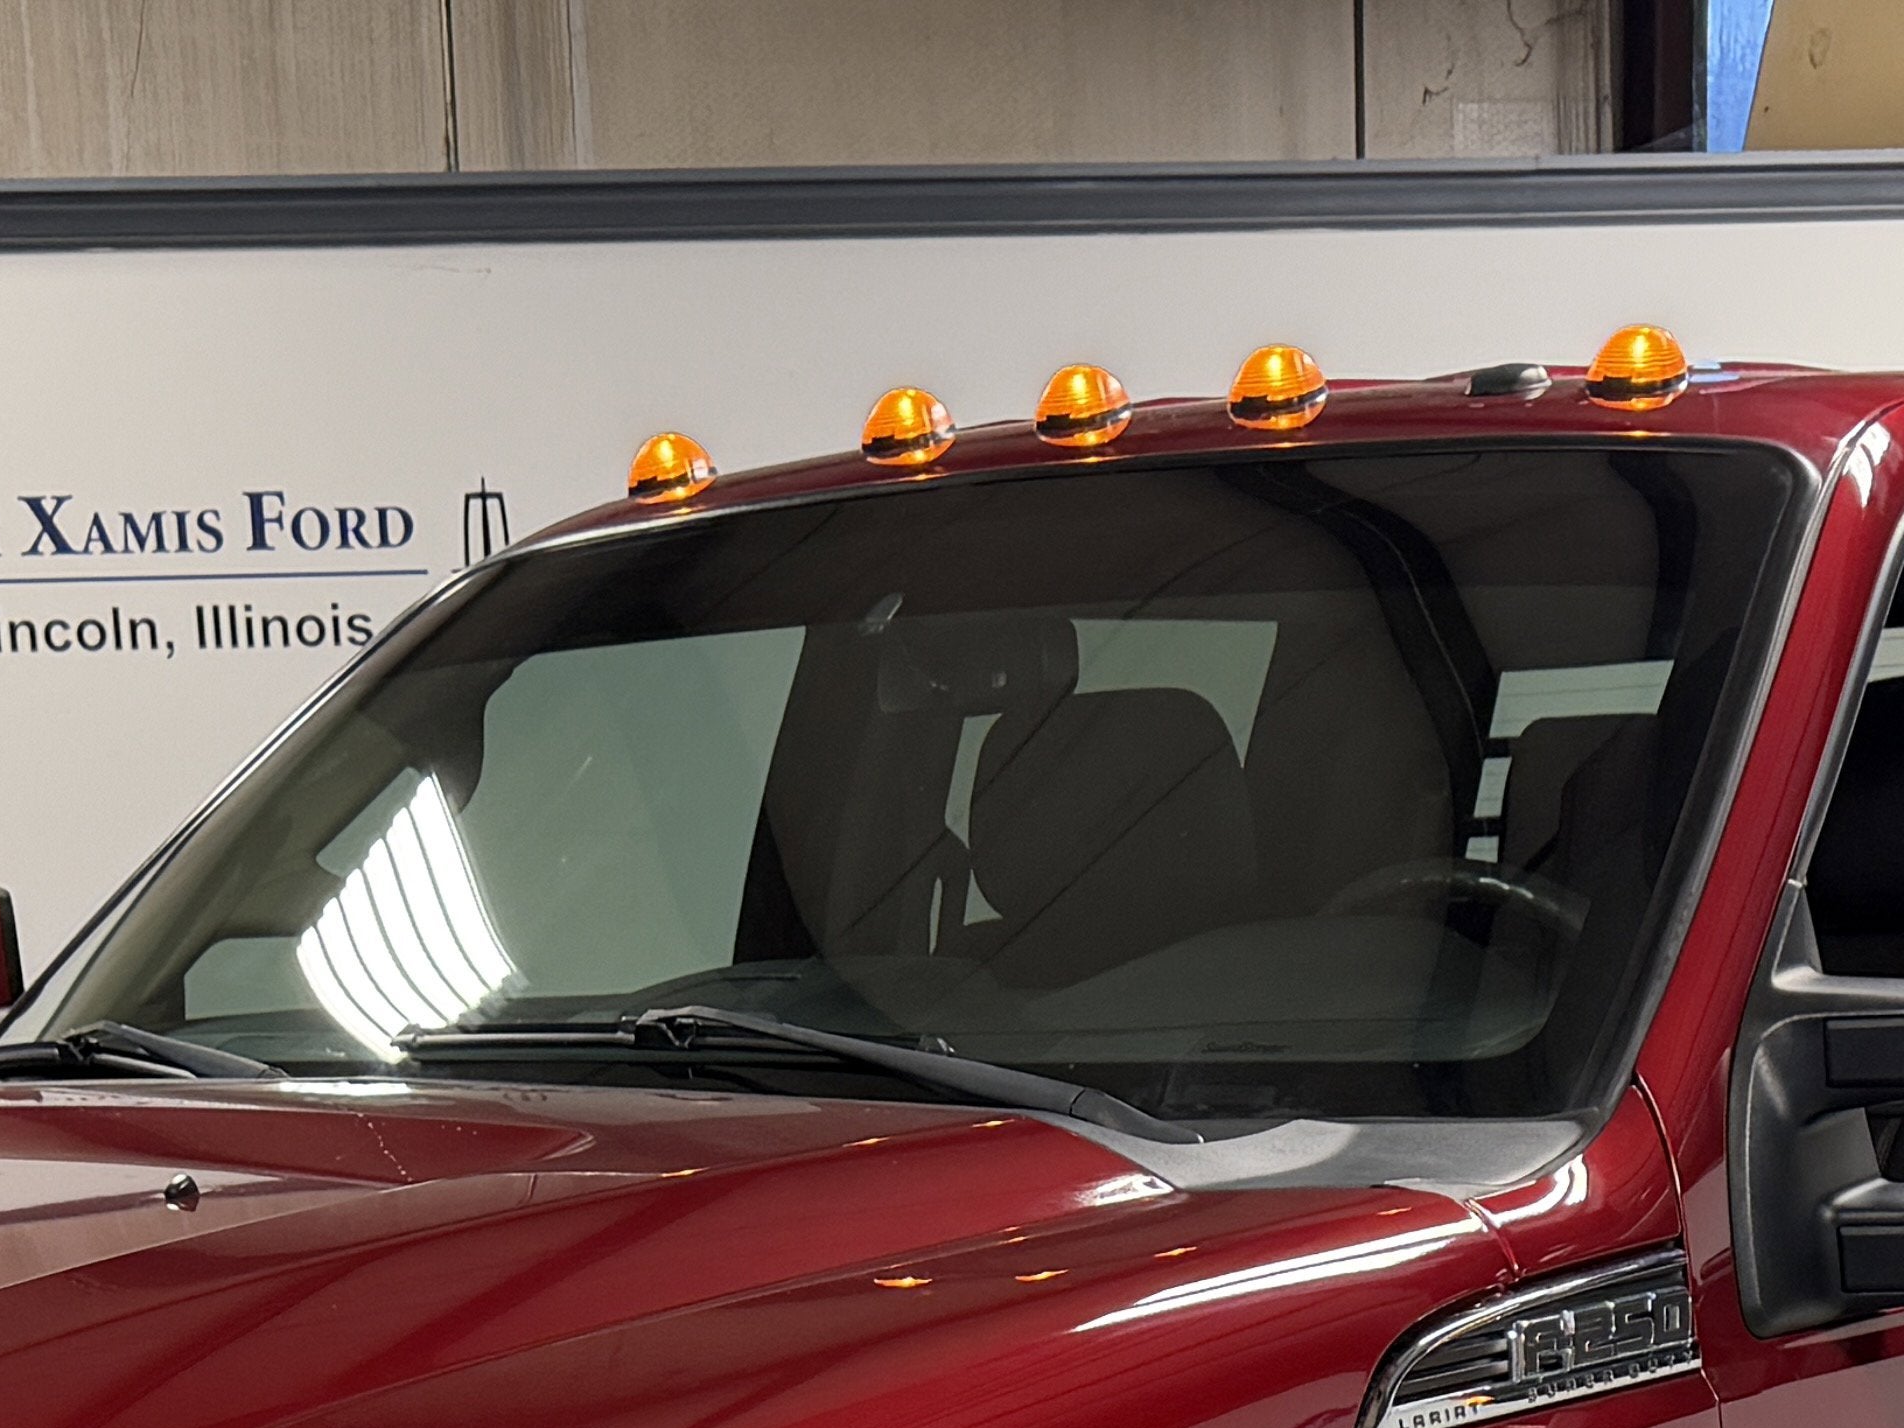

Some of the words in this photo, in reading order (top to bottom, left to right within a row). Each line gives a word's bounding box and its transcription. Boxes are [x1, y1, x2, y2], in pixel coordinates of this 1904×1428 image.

[18, 494, 225, 560] XAMIS
[244, 490, 415, 553] FORD
[196, 602, 374, 652] Illinois
[1527, 1368, 1616, 1403] SUPER
[1628, 1350, 1693, 1380] DUTY
